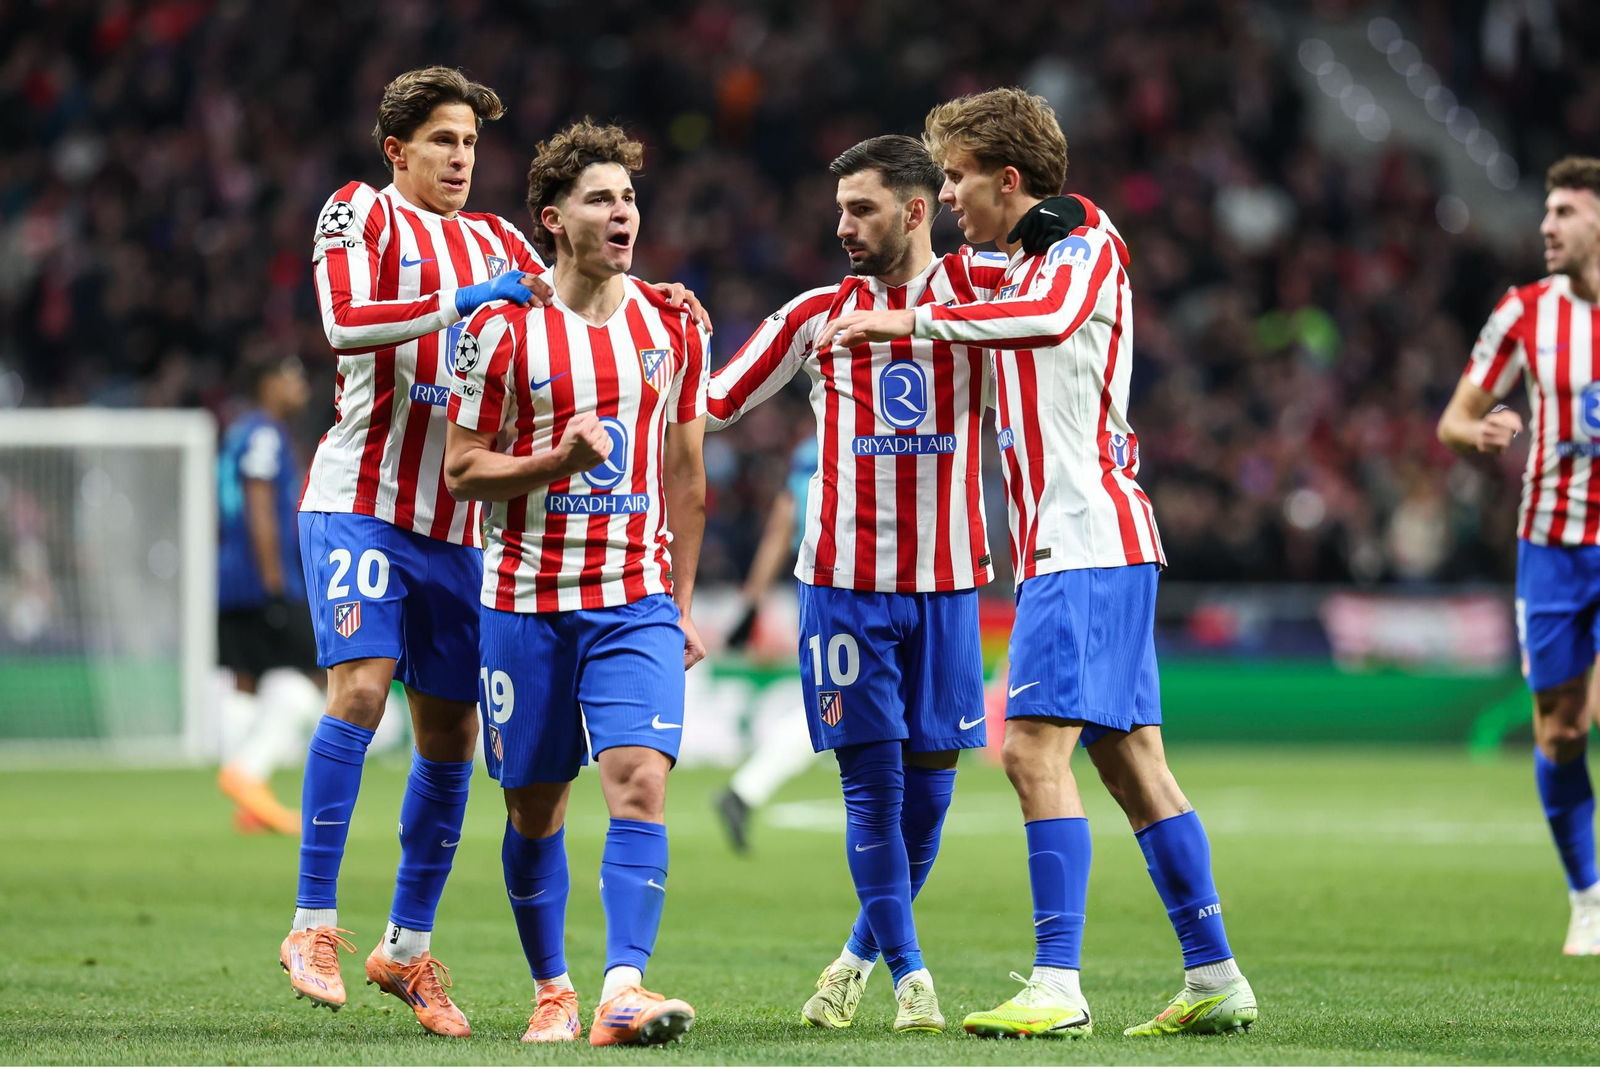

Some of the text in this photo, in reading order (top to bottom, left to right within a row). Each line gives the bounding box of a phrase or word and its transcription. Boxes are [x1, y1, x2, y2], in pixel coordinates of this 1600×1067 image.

[857, 437, 953, 453] RIYADH AIR
[549, 495, 647, 511] RIYADH AIR
[327, 548, 390, 600] 20
[808, 633, 860, 686] 10
[480, 667, 515, 724] 19
